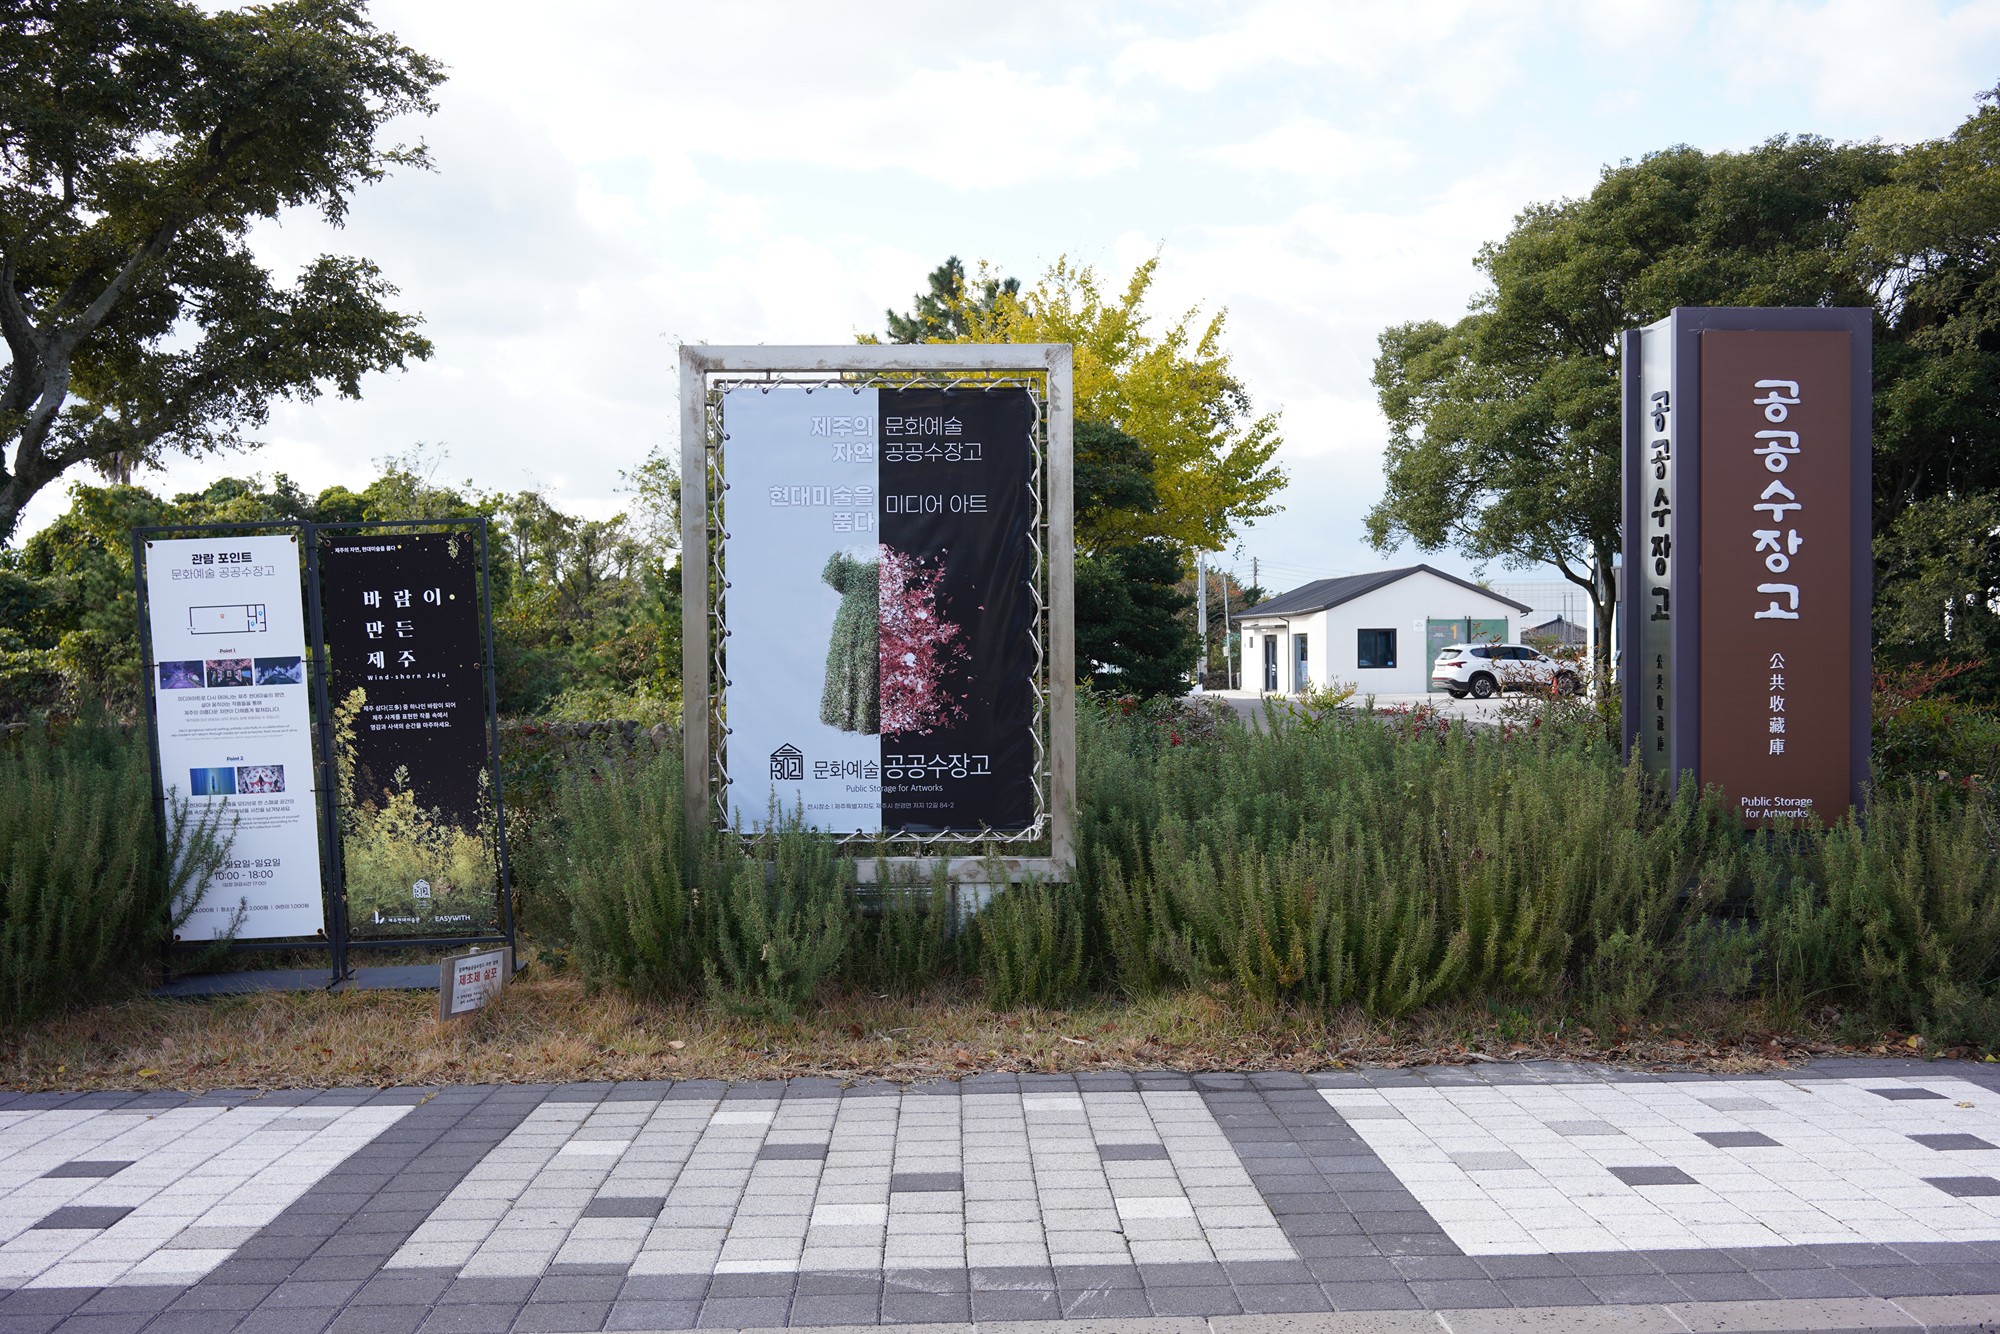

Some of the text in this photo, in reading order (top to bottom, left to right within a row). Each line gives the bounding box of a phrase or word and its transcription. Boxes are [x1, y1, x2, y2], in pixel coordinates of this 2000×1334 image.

[811, 416, 873, 437] 제주의
[885, 416, 963, 436] 문화예술
[832, 443, 873, 463] 자연
[885, 443, 982, 463] 공공수장고
[769, 485, 874, 507] 현대미술을
[886, 494, 988, 514] 미디어 아트
[1650, 390, 1671, 622] 공공수장고
[1752, 379, 1803, 620] 공공수장고
[832, 512, 875, 532] 품다
[191, 551, 253, 565] 관람 포인트
[171, 565, 276, 581] 문화예술 공공수장고
[367, 672, 447, 681] Wind-shorn Jeju
[1768, 652, 1785, 756] 公共收藏庫
[812, 753, 992, 779] 문화예술 공공수장고
[846, 784, 943, 793] Public Storage for Artworks
[1741, 796, 1813, 808] Public Storage
[1745, 808, 1809, 818] for Artworks
[215, 871, 239, 880] 10:00
[248, 870, 274, 879] 18:00
[435, 915, 471, 923] EASYWITH
[459, 968, 497, 985] 제초제 살포
